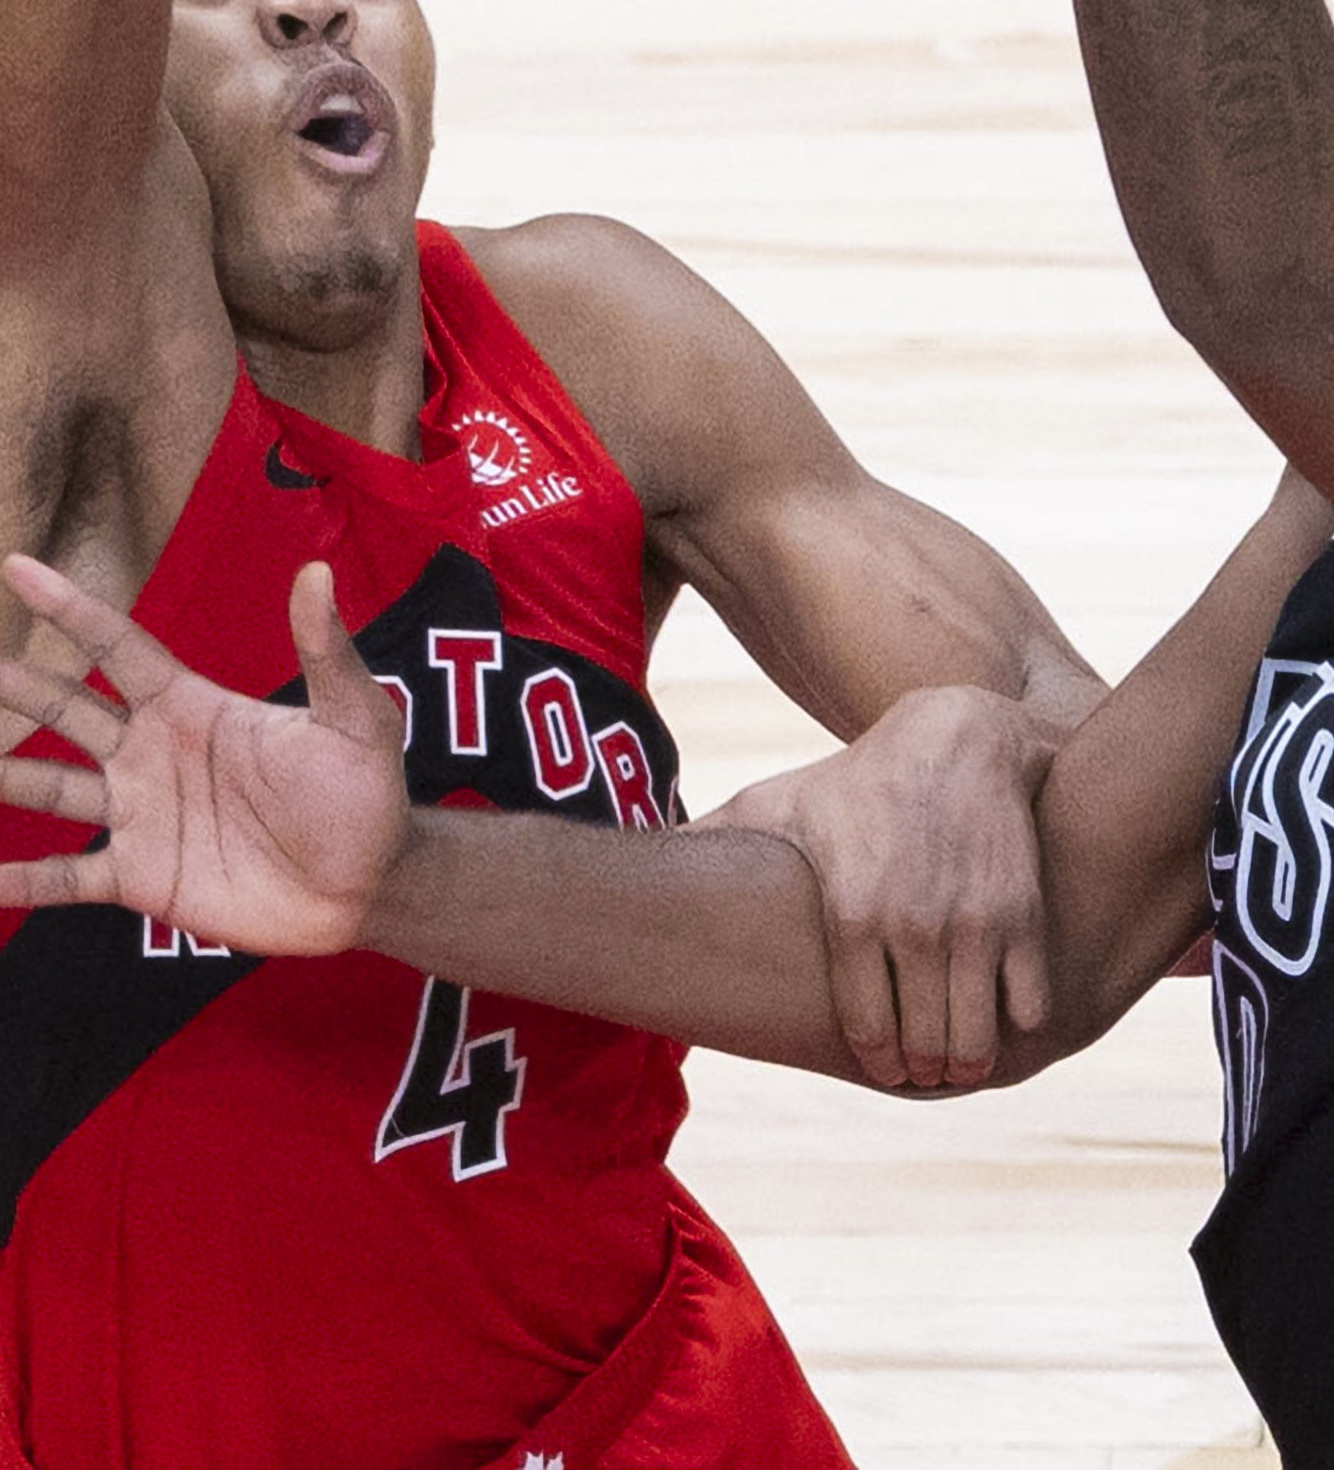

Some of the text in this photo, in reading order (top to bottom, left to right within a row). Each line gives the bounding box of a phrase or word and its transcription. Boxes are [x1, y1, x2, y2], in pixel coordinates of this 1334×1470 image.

[480, 471, 583, 529] un Life
[371, 627, 680, 832] TOR
[374, 974, 528, 1183] 4
